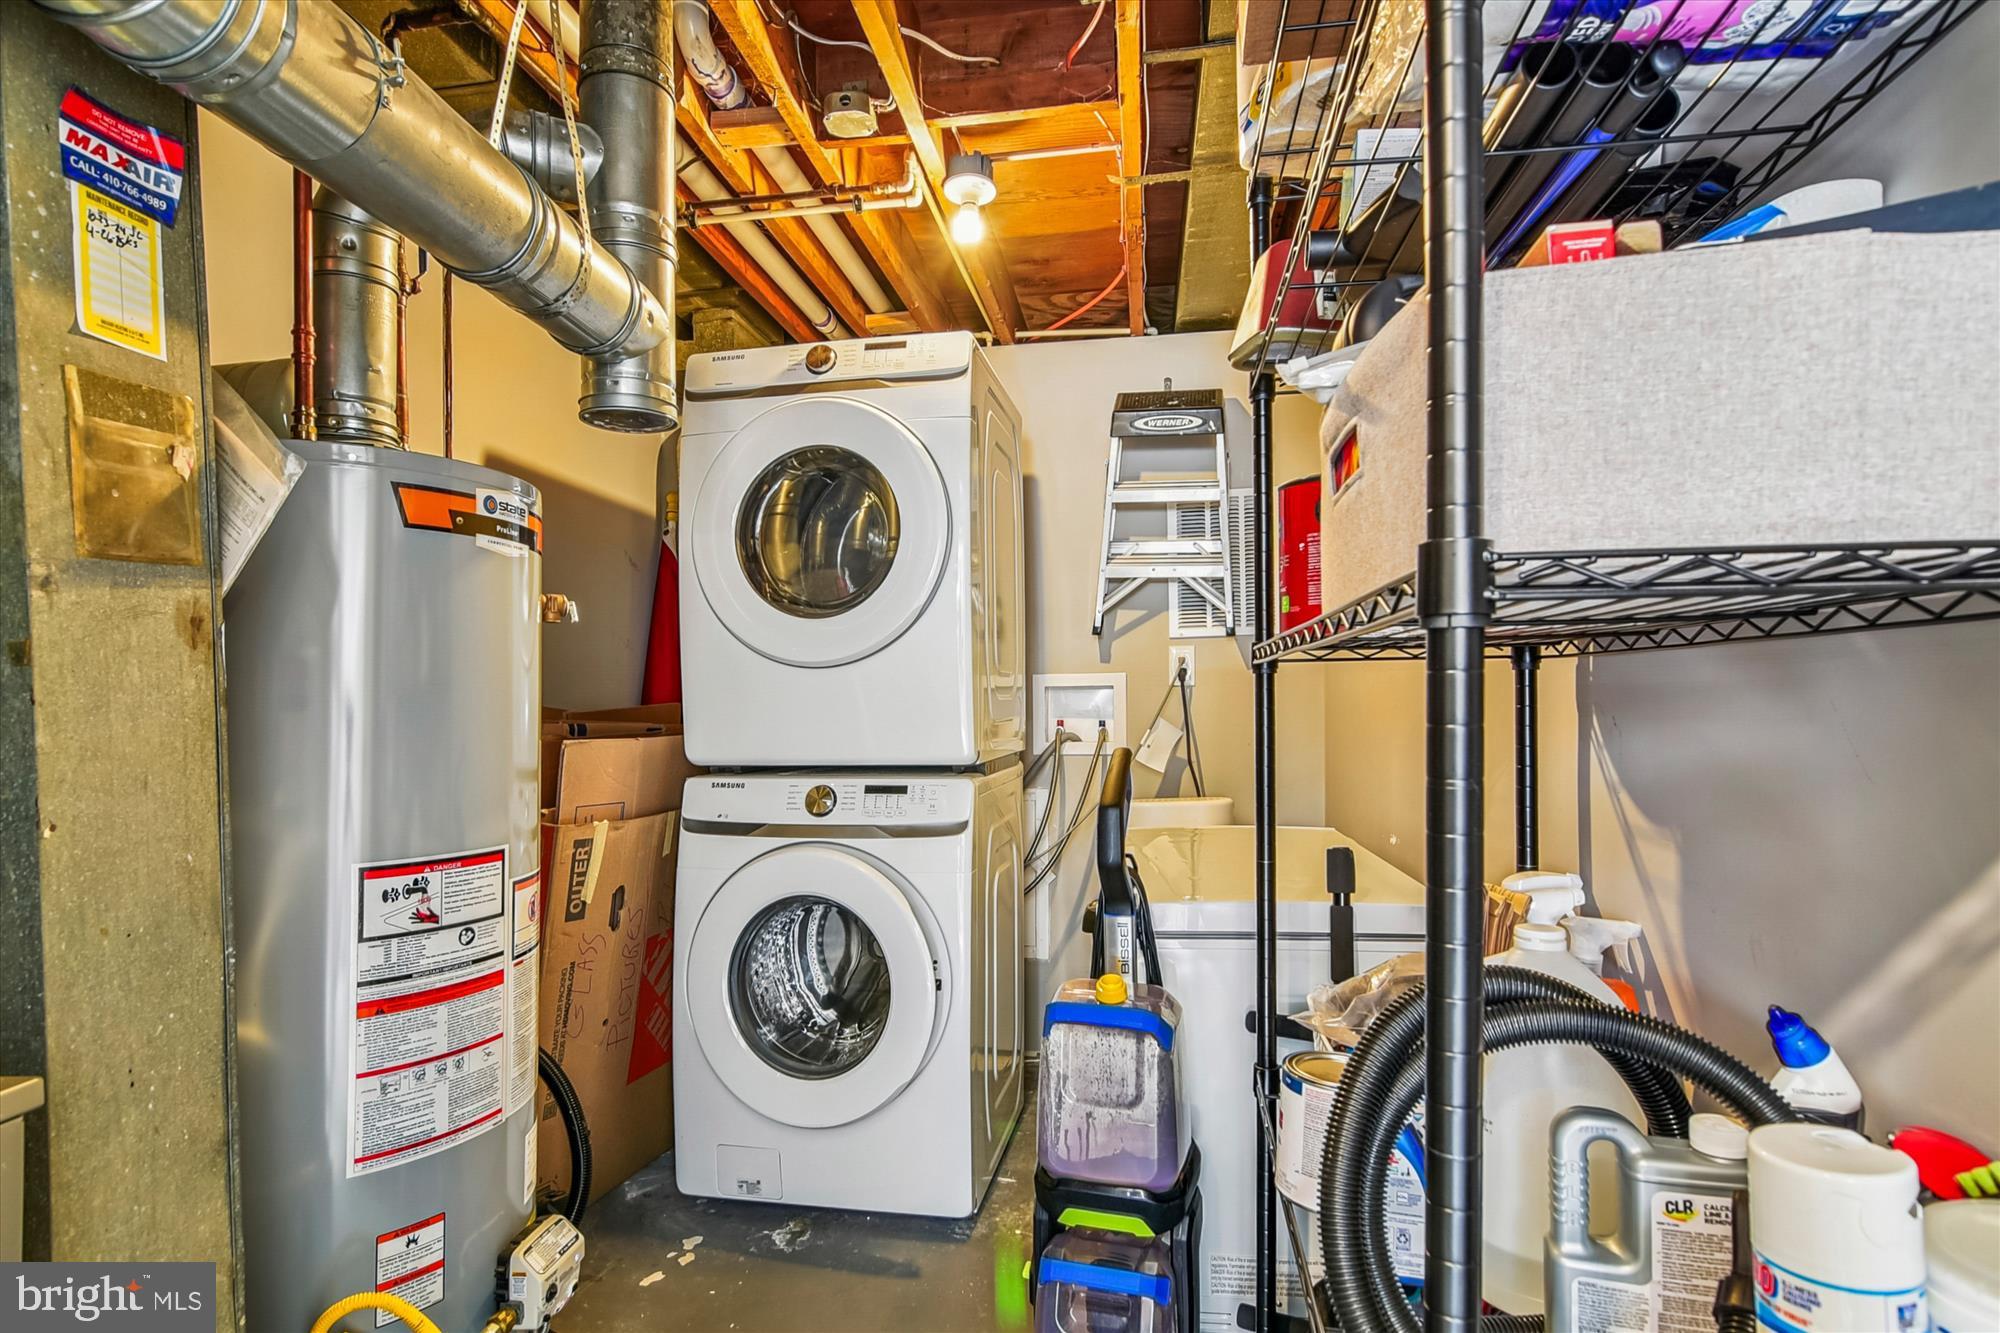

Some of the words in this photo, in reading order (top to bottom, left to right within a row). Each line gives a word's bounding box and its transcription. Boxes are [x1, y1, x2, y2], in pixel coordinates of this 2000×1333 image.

[103, 115, 116, 128] NOT
[65, 128, 175, 193] MAXAIR
[70, 155, 100, 178] CALL:
[102, 172, 167, 211] 410-766-4989
[711, 354, 746, 362] SAMSUNG
[1147, 418, 1190, 428] WERNER
[498, 501, 527, 518] state
[711, 781, 746, 789] SAMSUNG
[433, 862, 462, 871] DANGER
[569, 845, 592, 914] OUTER
[567, 932, 607, 1040] GLASS
[605, 905, 645, 1052] PICTURES
[1665, 1199, 1694, 1215] CLR
